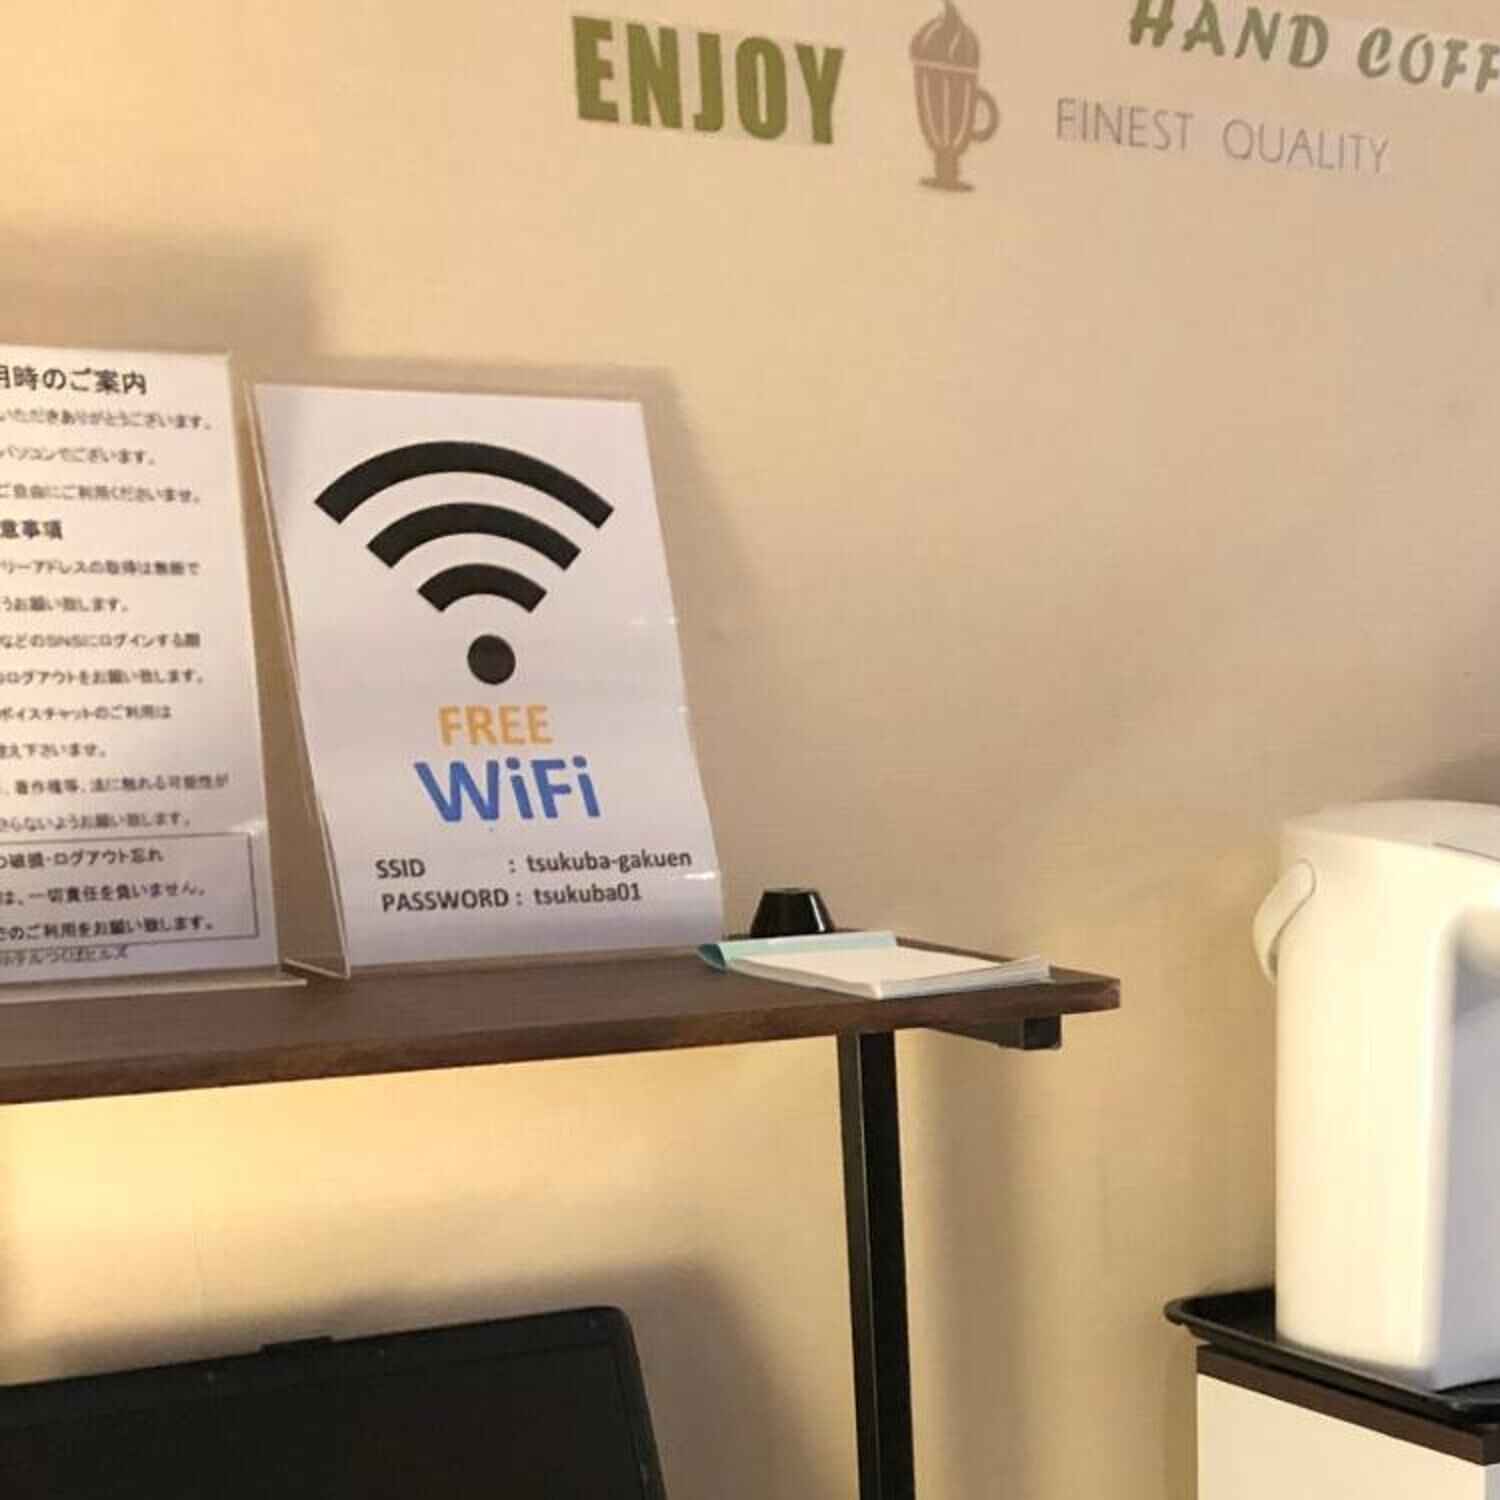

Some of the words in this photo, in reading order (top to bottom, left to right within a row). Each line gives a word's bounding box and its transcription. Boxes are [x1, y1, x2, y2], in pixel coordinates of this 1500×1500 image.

[1130, 0, 1329, 68] HAND
[572, 15, 845, 146] ENJOY
[1056, 97, 1196, 152] FINEST
[1222, 118, 1390, 175] QUALITY
[437, 704, 553, 747] FREE
[414, 756, 601, 823] WiFi
[375, 857, 426, 879] SSID
[527, 849, 693, 875] tsukuba-gakuen
[382, 888, 509, 912] PASSWORD
[533, 883, 642, 905] tsukuba01
